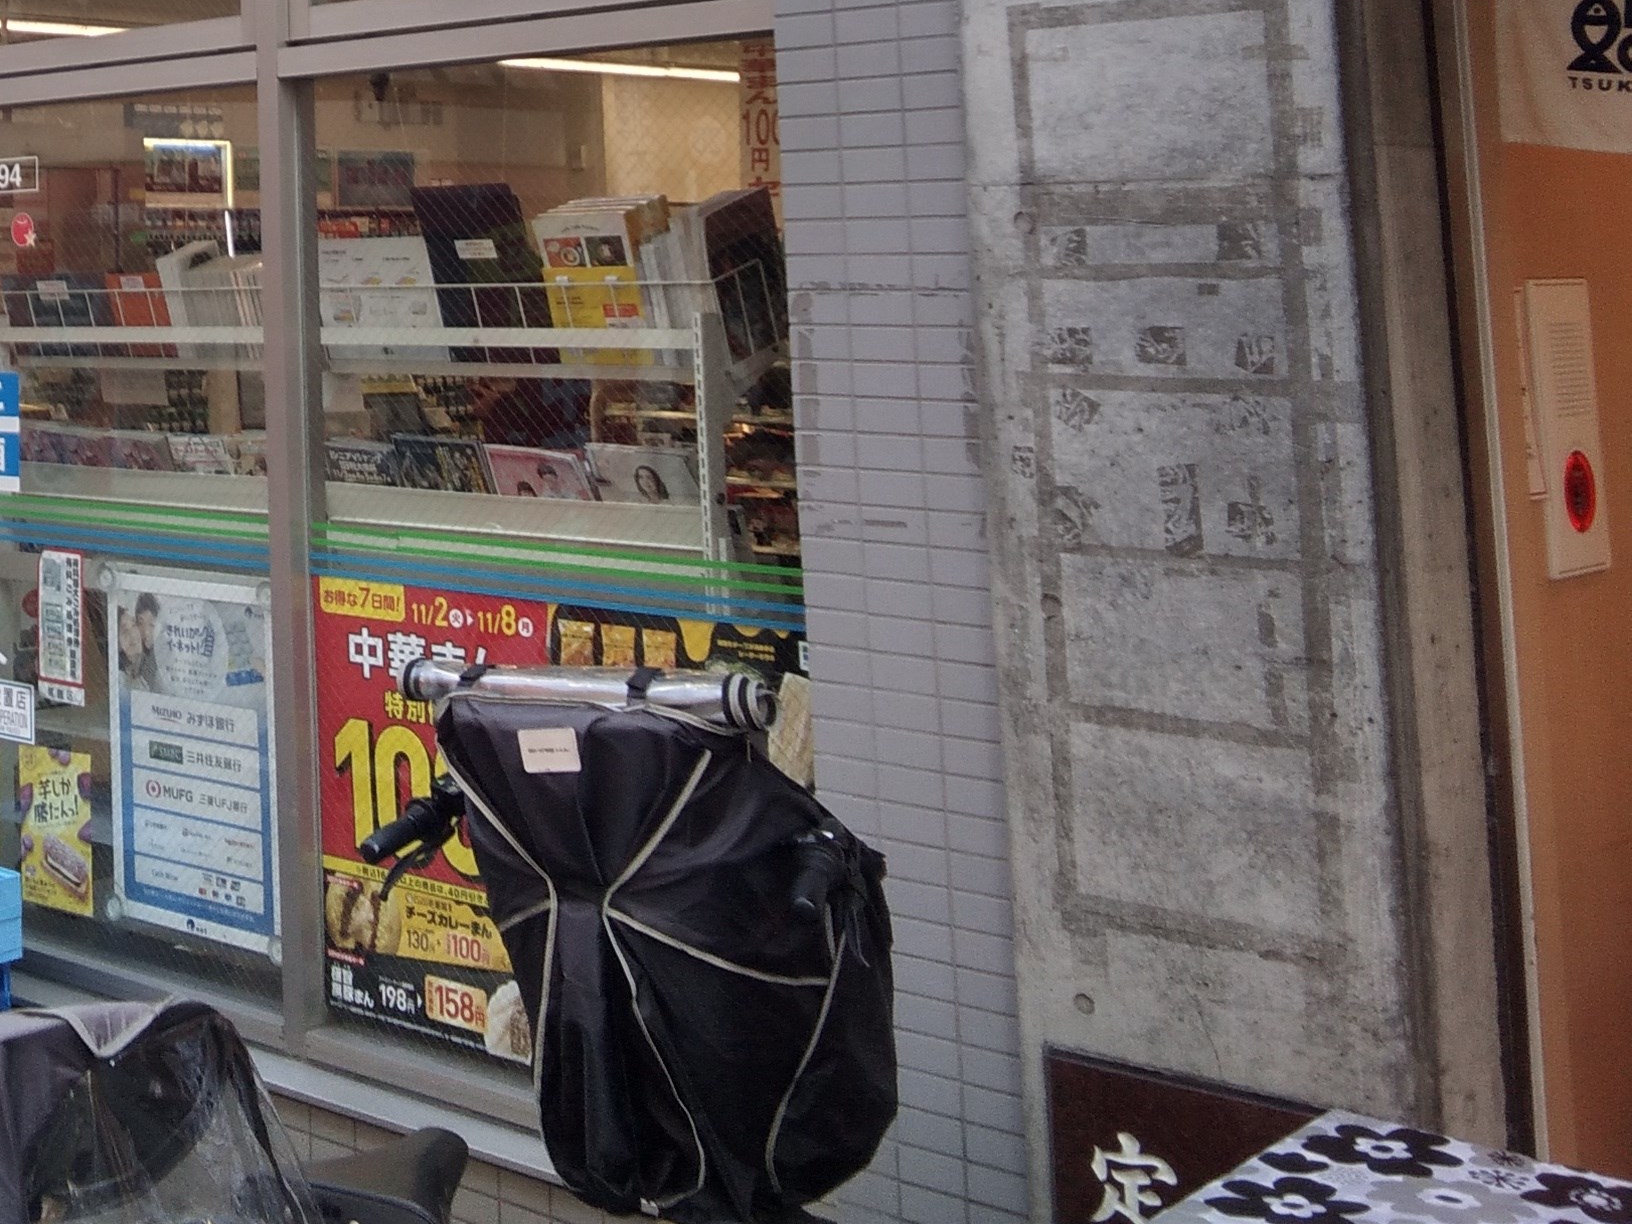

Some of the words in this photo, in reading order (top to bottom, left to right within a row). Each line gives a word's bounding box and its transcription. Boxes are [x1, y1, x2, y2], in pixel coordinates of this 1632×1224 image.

[323, 587, 401, 613] お得な7日間!
[384, 690, 435, 725] 特別
[186, 712, 236, 733] みずほ銀行
[186, 750, 243, 773] 三井住友銀行
[38, 779, 71, 800] 芋しか
[163, 785, 194, 803] MUFG
[405, 905, 493, 939] チーズカレーまん
[378, 983, 416, 1015] 198円
[435, 983, 486, 1028] 158円
